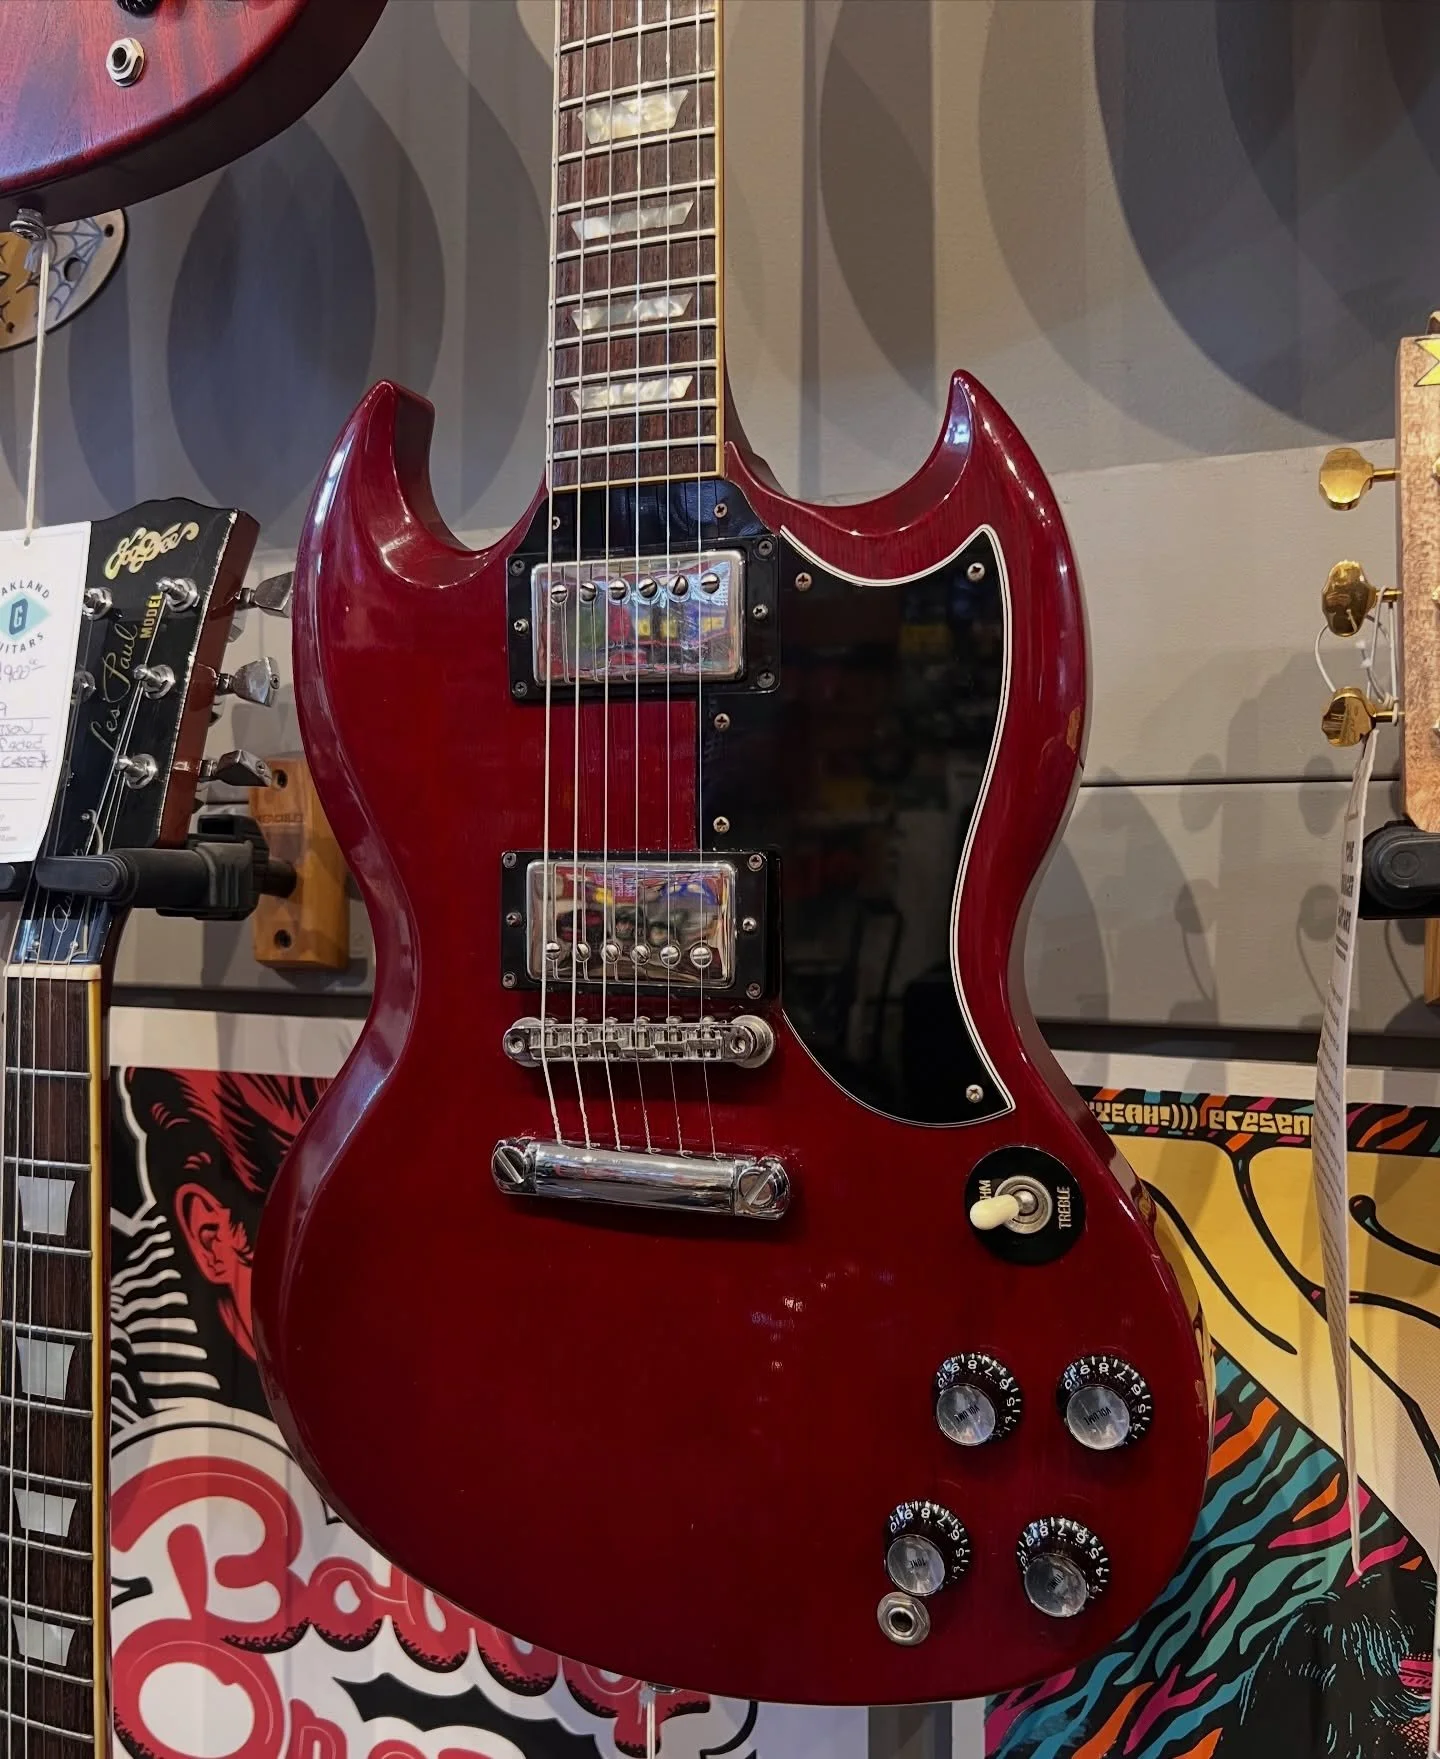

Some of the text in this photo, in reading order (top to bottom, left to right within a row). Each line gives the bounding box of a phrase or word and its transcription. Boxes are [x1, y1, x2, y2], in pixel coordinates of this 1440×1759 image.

[1, 580, 50, 599] AKLAND
[140, 592, 163, 639] MODEL
[0, 632, 44, 654] UITARS
[102, 623, 138, 703] Paul
[1089, 1101, 1198, 1130] YEAH!)))
[1057, 1186, 1072, 1229] TREBLE
